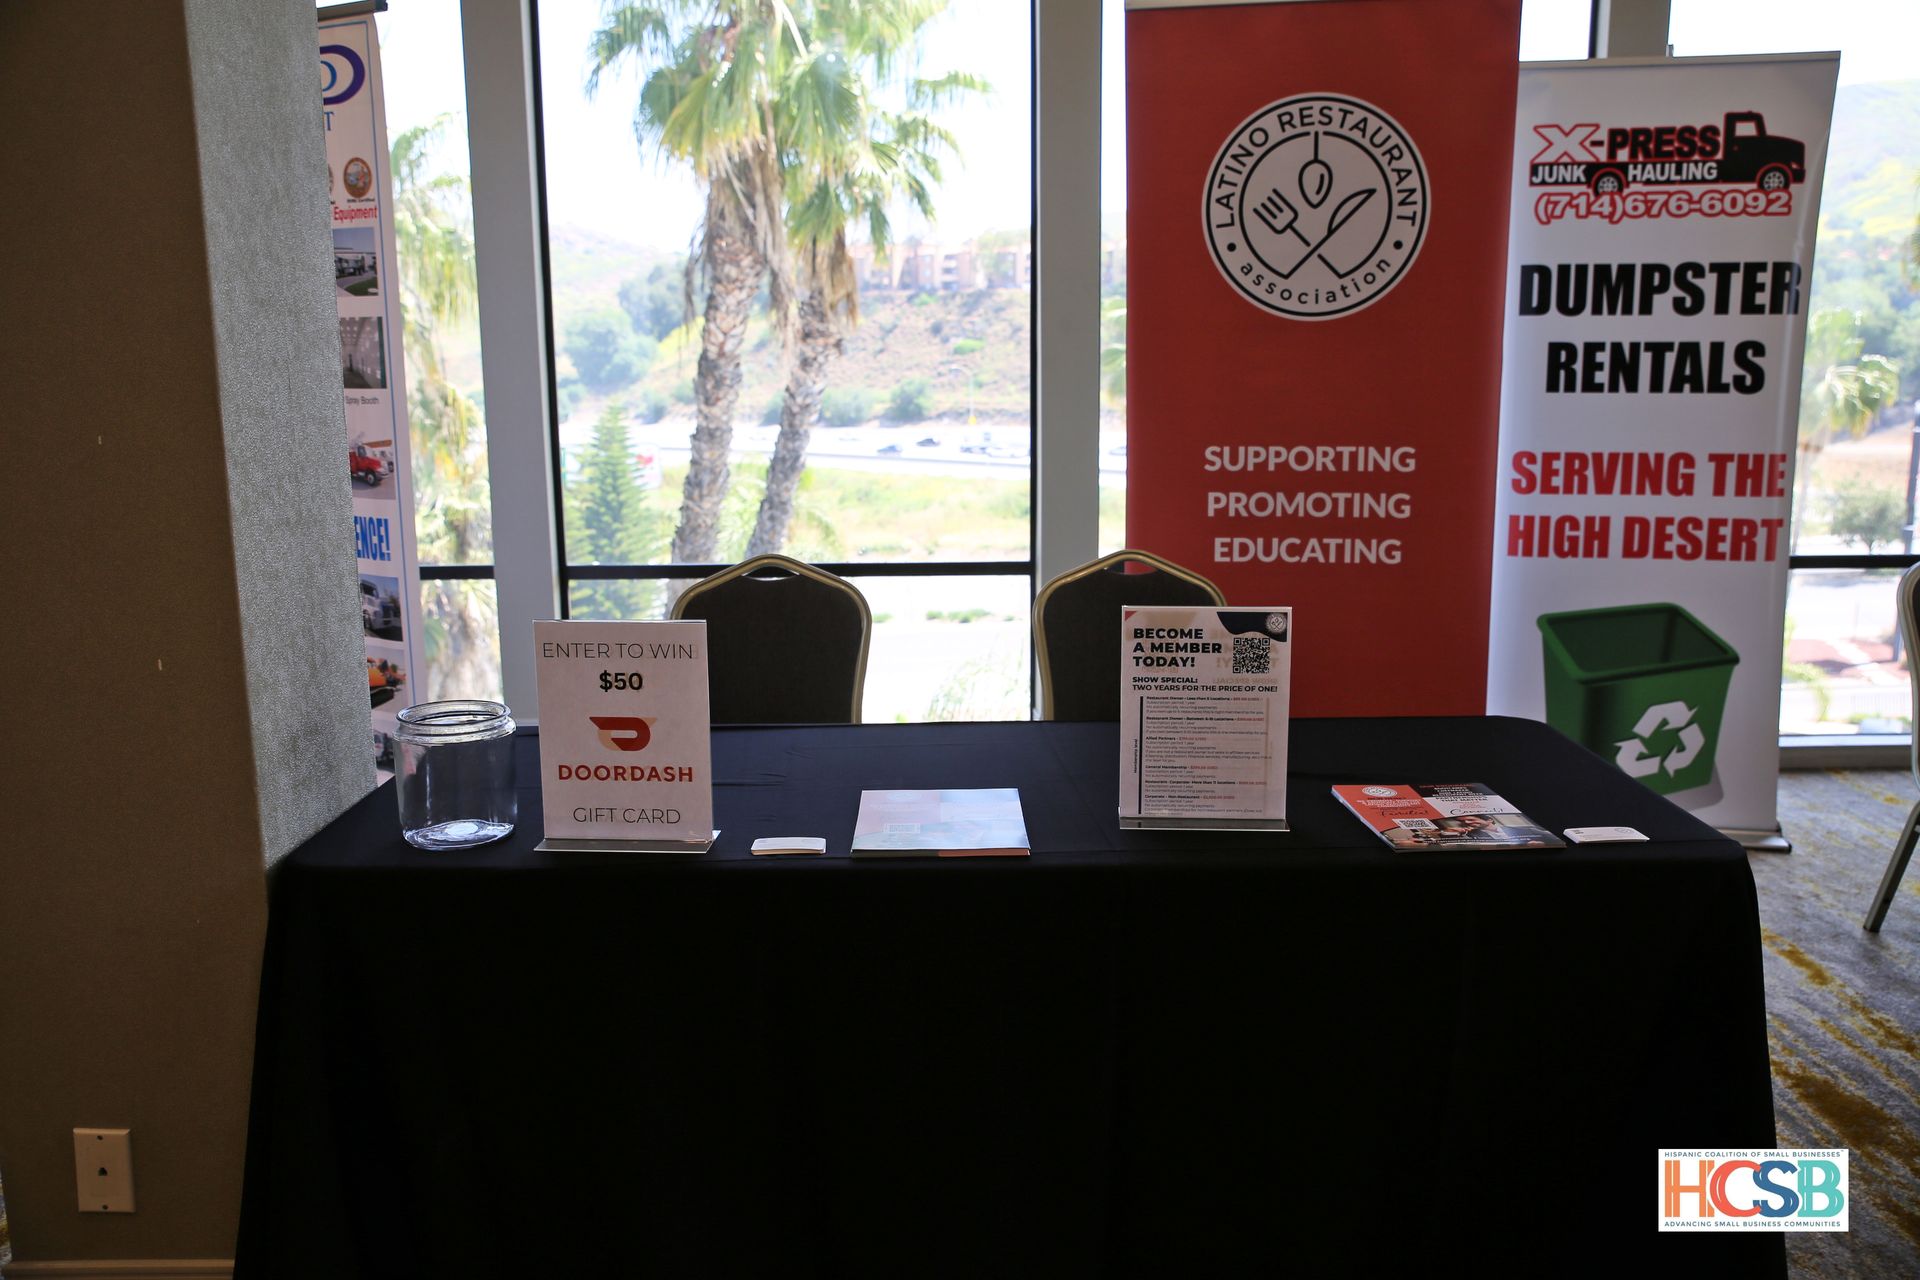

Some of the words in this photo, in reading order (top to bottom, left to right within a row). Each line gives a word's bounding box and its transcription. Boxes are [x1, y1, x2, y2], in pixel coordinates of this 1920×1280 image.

[1532, 123, 1722, 163] X-PRESS
[1215, 127, 1269, 228] LATINO
[1276, 105, 1418, 227] RESTAURANT
[1531, 164, 1587, 183] JUNK
[1627, 162, 1718, 182] HAULING
[333, 205, 378, 222] Equipment
[1534, 189, 1793, 225] (714)676-6092
[1240, 257, 1392, 304] association
[1518, 261, 1802, 316] DUMPSTER
[1545, 340, 1767, 395] RENTALS
[1204, 446, 1416, 472] SUPPORTING
[1511, 451, 1696, 496] SERVING
[1707, 452, 1788, 499] THE
[1207, 492, 1411, 519] PROMOTING
[1213, 537, 1402, 564] EDUCATING
[1507, 514, 1611, 560] HIGH
[1621, 516, 1784, 563] DESERT
[1133, 628, 1204, 640] BECOME
[543, 642, 610, 659] ENTER
[615, 643, 644, 659] TO
[649, 643, 693, 660] WIN
[1133, 642, 1145, 653] A
[1150, 642, 1222, 654] MEMBER
[1132, 656, 1196, 668] TODAY!
[599, 670, 643, 692] $50
[1132, 676, 1159, 684] SHOW
[1154, 684, 1181, 692] YEARS
[558, 764, 693, 782] DOORDASH
[573, 807, 617, 823] GIFT
[622, 808, 681, 824] CARD
